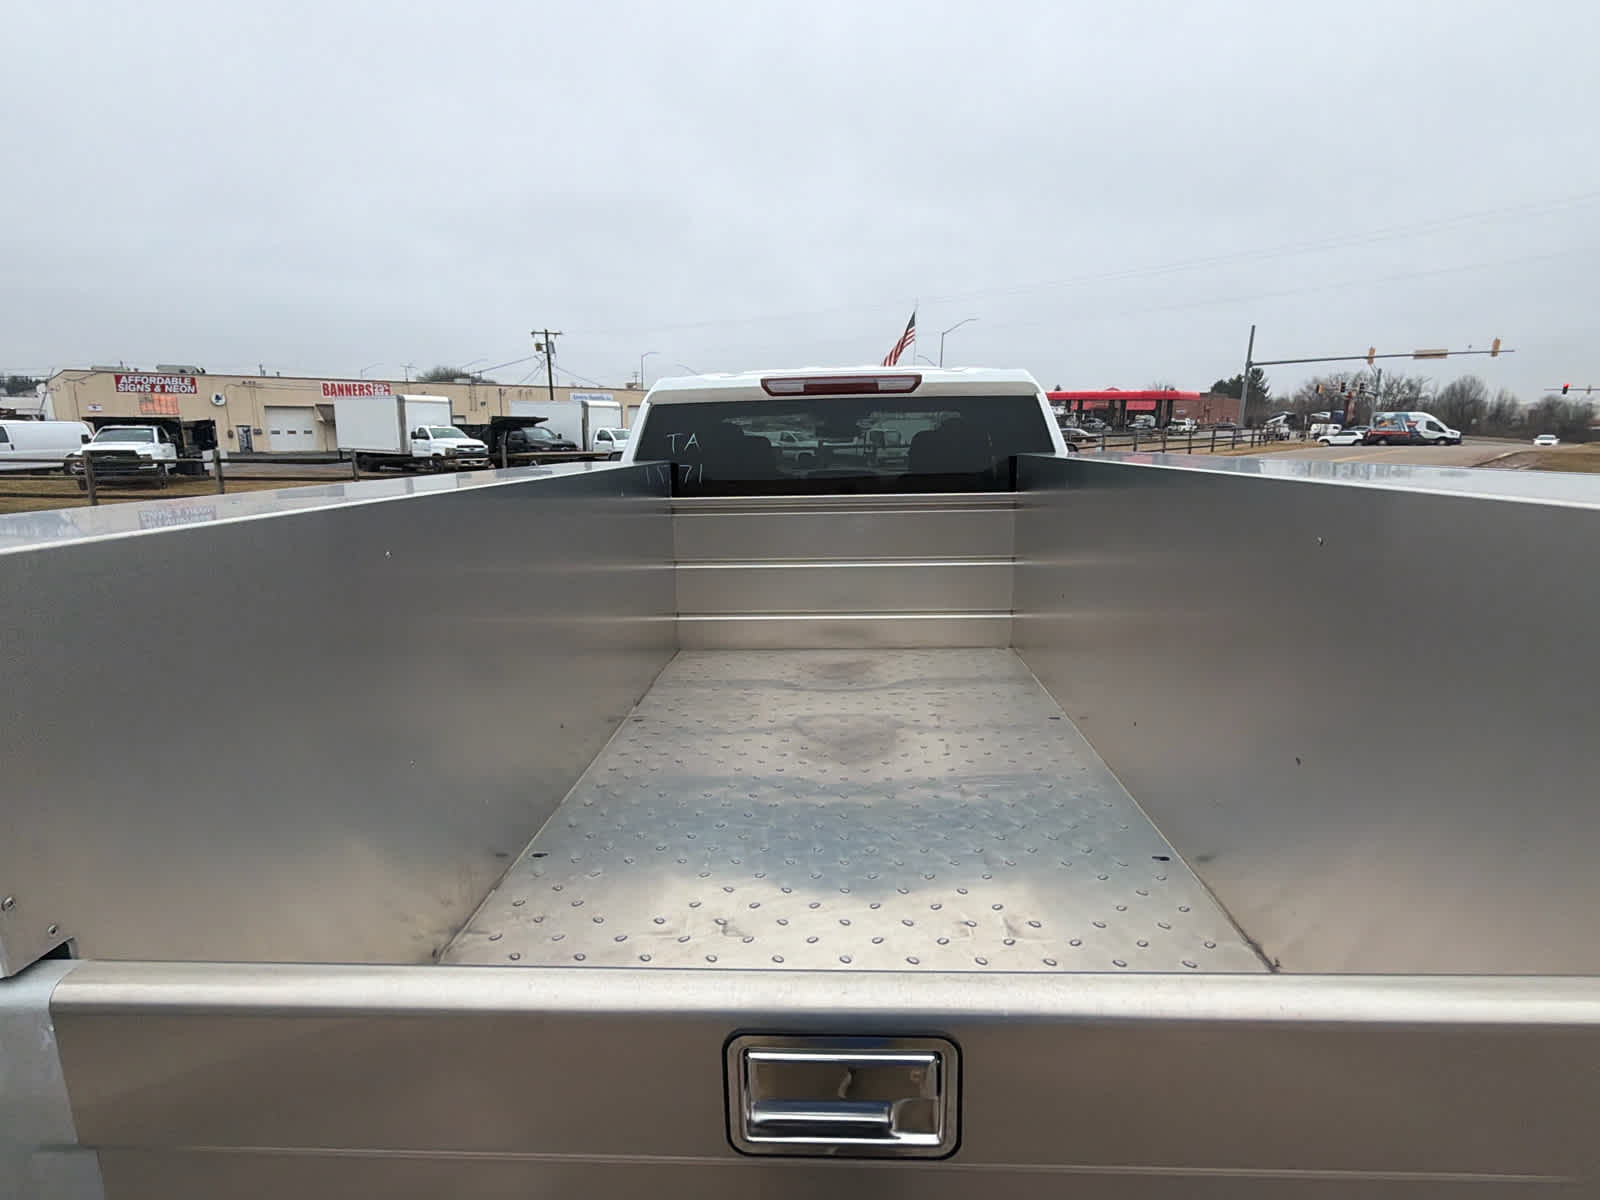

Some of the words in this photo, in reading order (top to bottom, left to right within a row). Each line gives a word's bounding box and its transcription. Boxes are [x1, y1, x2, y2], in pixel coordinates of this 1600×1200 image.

[120, 376, 191, 385] AFFORDABLE
[118, 384, 151, 392] SIGNS
[153, 385, 161, 393] &
[165, 385, 195, 393] NEON
[322, 383, 372, 396] BANNERS
[666, 432, 700, 454] TA
